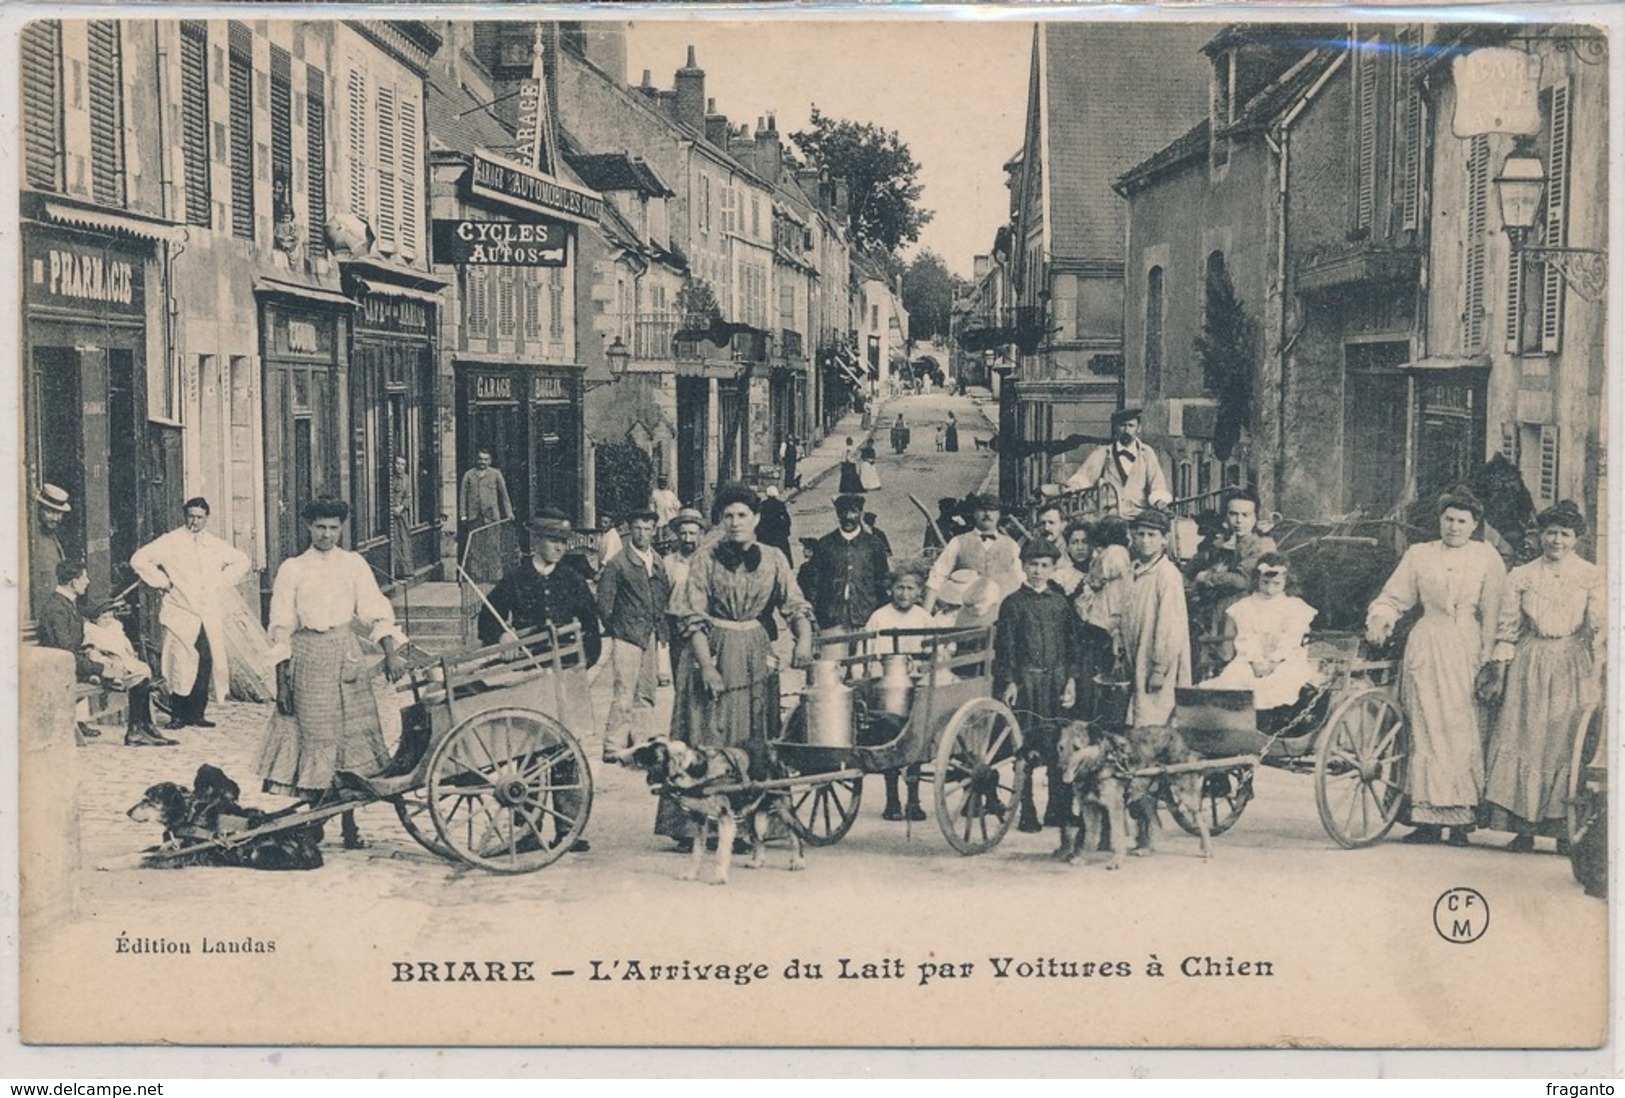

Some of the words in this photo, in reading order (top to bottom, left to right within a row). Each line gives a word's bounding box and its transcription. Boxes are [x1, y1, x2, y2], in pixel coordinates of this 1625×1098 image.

[457, 222, 548, 242] CYCLES
[469, 244, 538, 263] AUTOS
[49, 249, 132, 304] PHARMACIE
[477, 376, 511, 398] GARAGE
[115, 930, 191, 954] Édition
[202, 937, 276, 954] Landas
[392, 961, 535, 982] BRIARE
[589, 960, 769, 986] L'Arrivage
[783, 958, 823, 980] du
[838, 958, 905, 979] Lait
[918, 962, 974, 986] par
[989, 957, 1132, 978] Voitures
[1145, 954, 1164, 977] à
[1180, 956, 1274, 977] Chien
